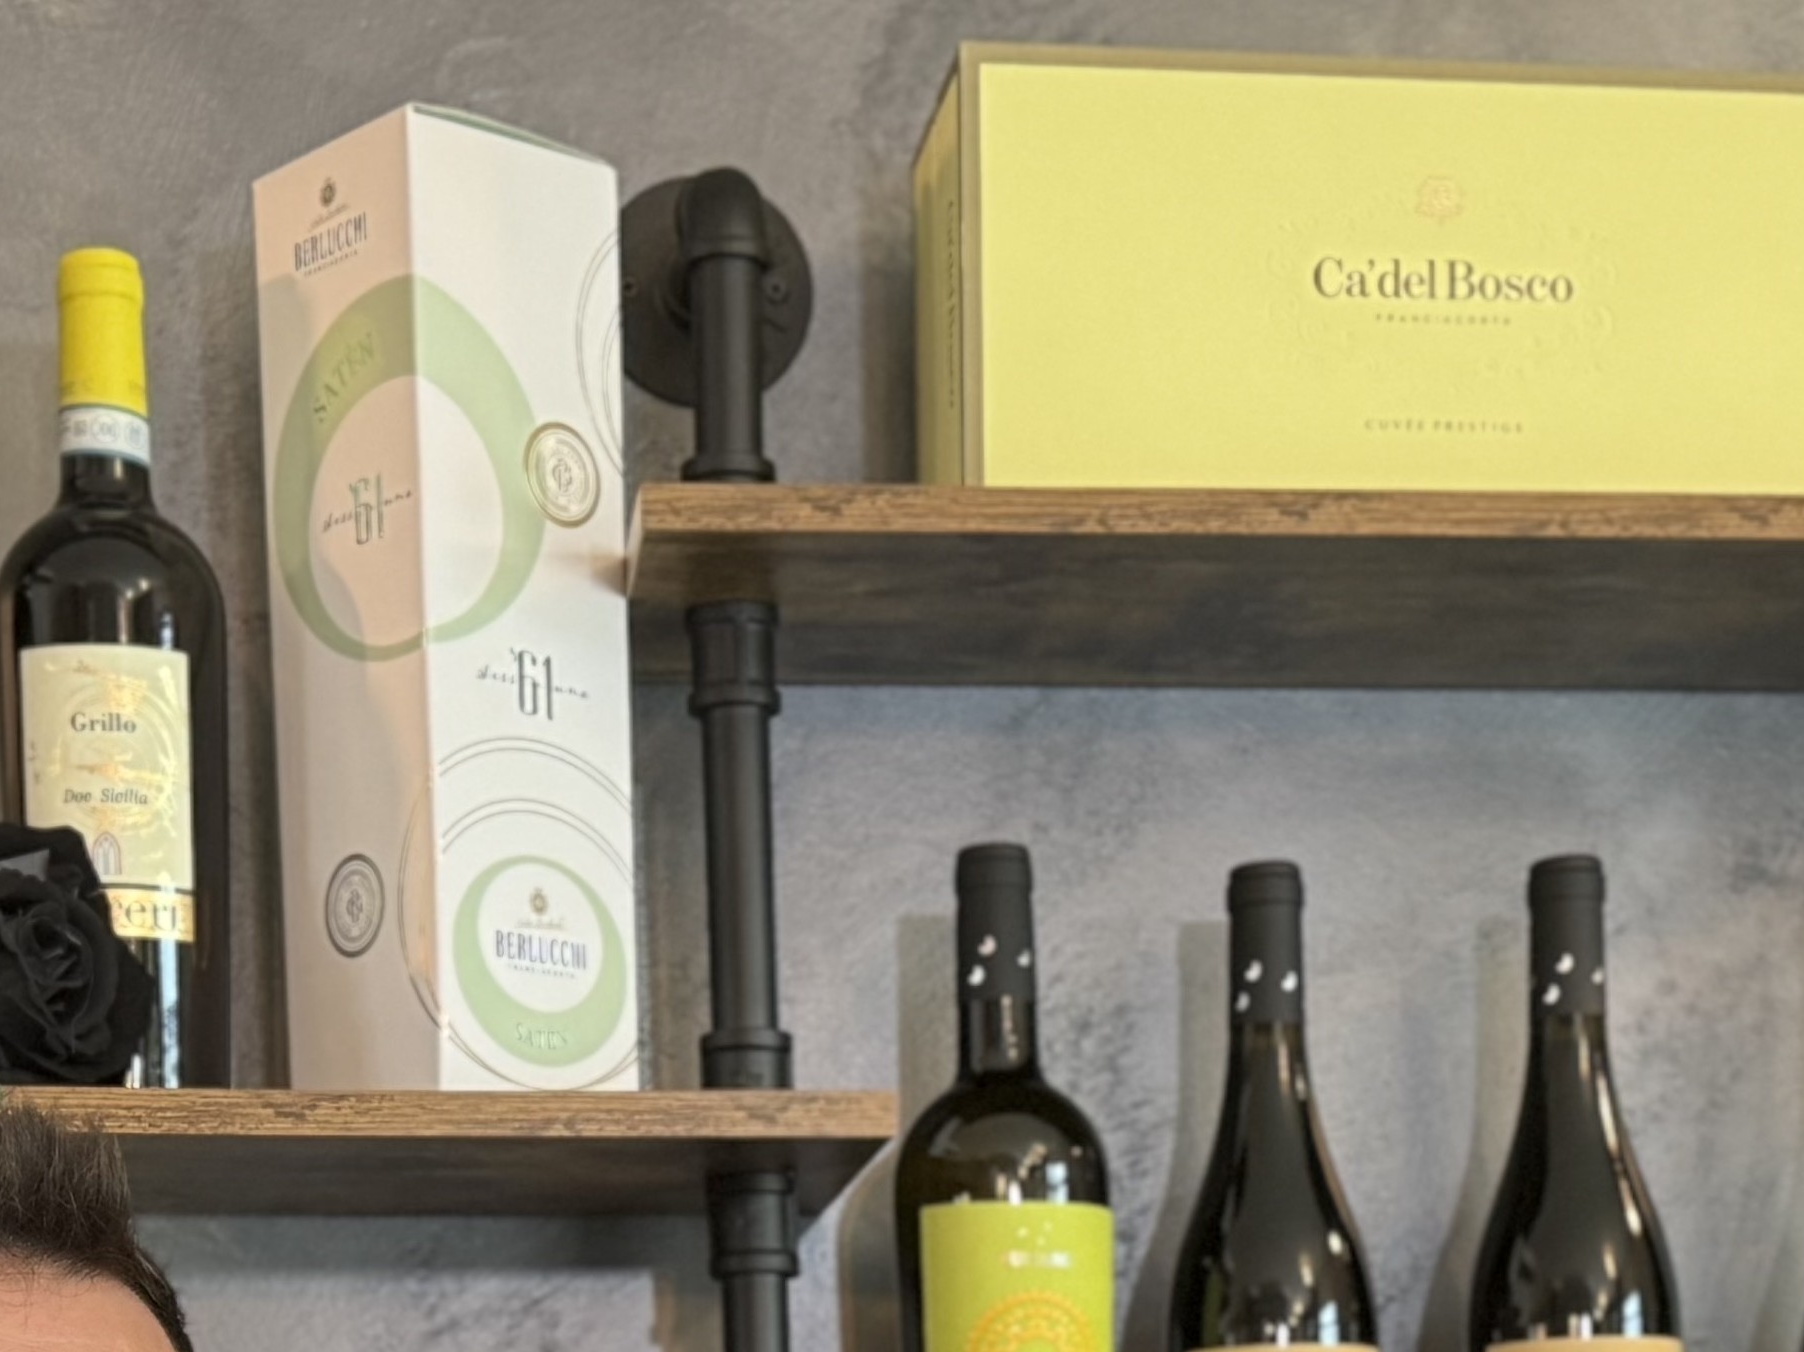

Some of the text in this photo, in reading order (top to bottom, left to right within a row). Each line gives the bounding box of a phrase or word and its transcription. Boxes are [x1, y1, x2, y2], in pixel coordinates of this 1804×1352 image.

[293, 211, 368, 272] BERLUCCHI
[1447, 258, 1575, 303] Bosco
[69, 711, 138, 734] Grillo
[99, 787, 150, 806] Sicilia
[495, 929, 587, 971] BERLUCCHI
